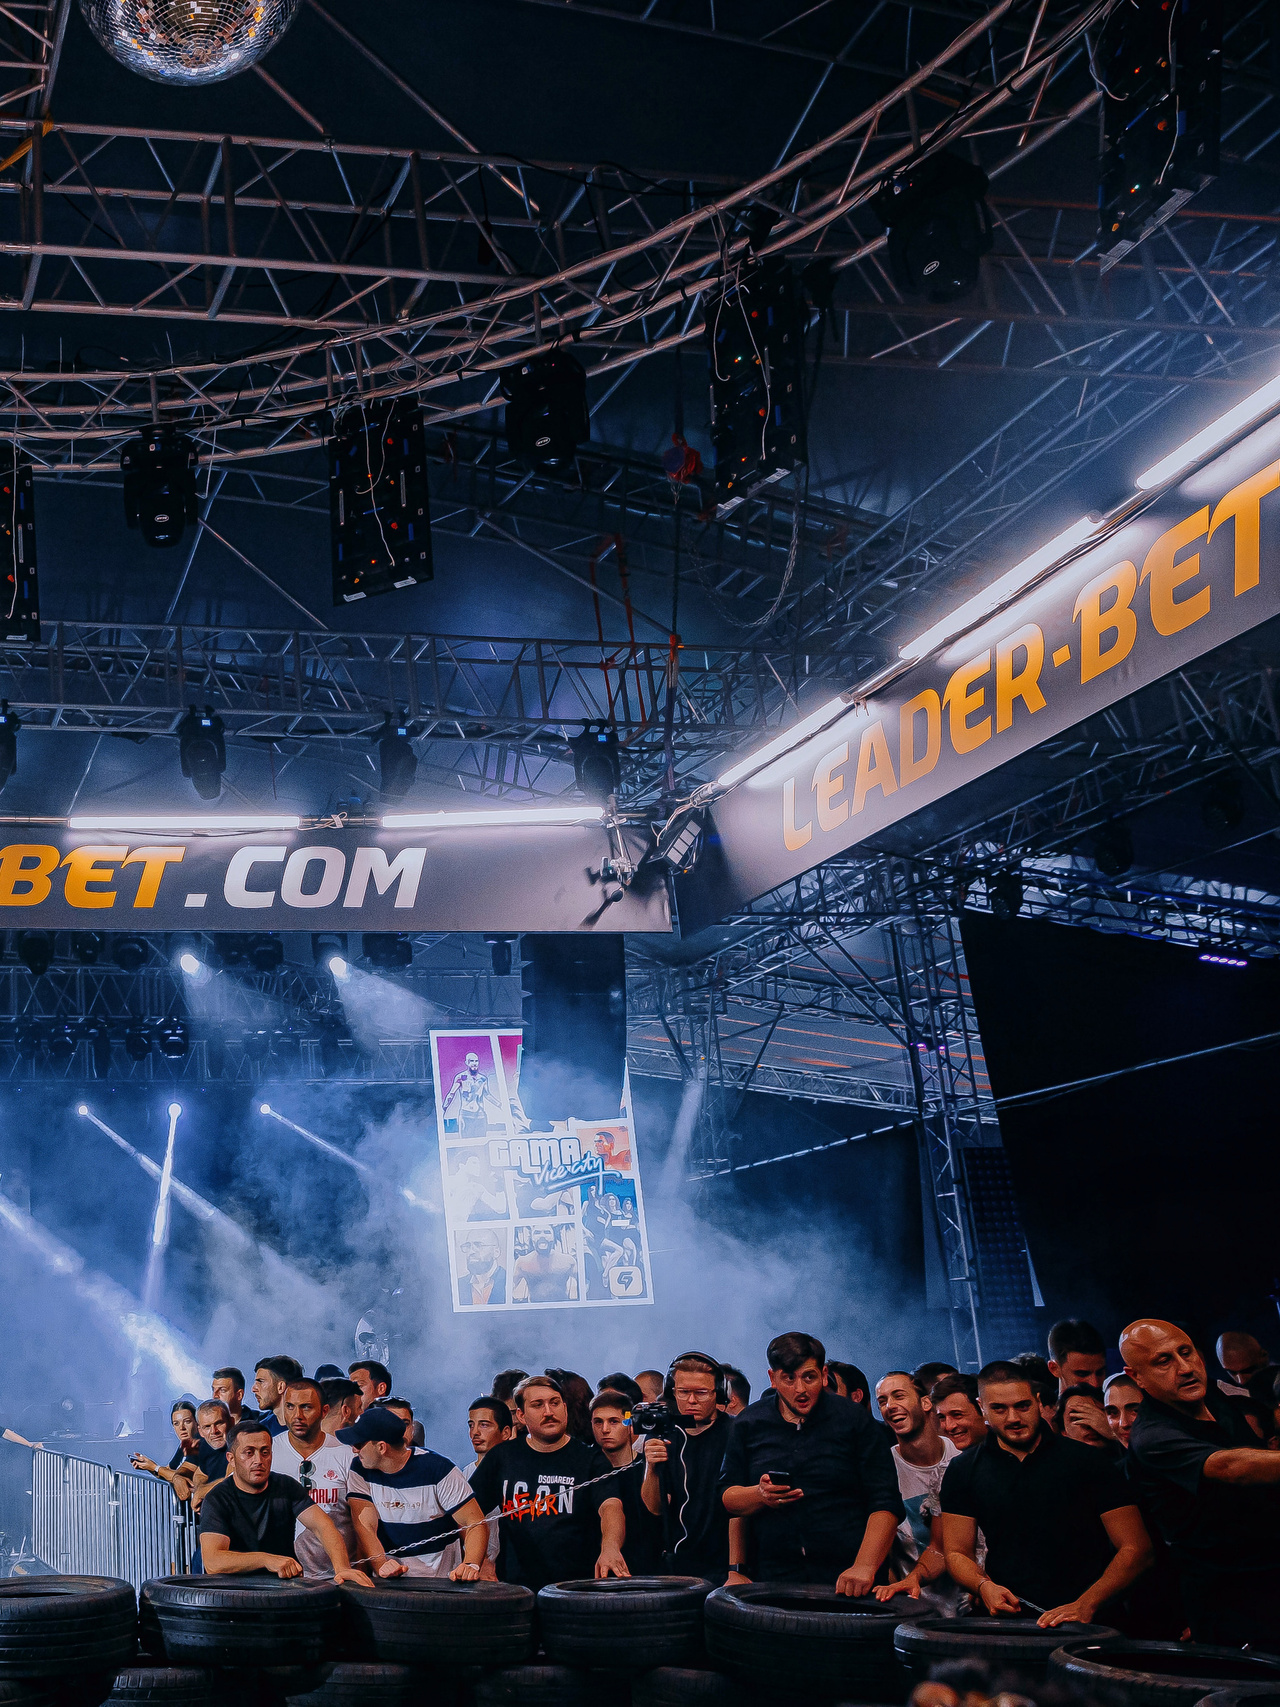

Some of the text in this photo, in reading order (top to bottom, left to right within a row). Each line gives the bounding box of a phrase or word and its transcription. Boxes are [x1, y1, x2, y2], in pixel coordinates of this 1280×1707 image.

[489, 1138, 581, 1174] GAMA
[534, 1160, 568, 1185] Vice
[537, 1474, 575, 1486] DSQUARED2
[308, 1487, 338, 1504] ORLD
